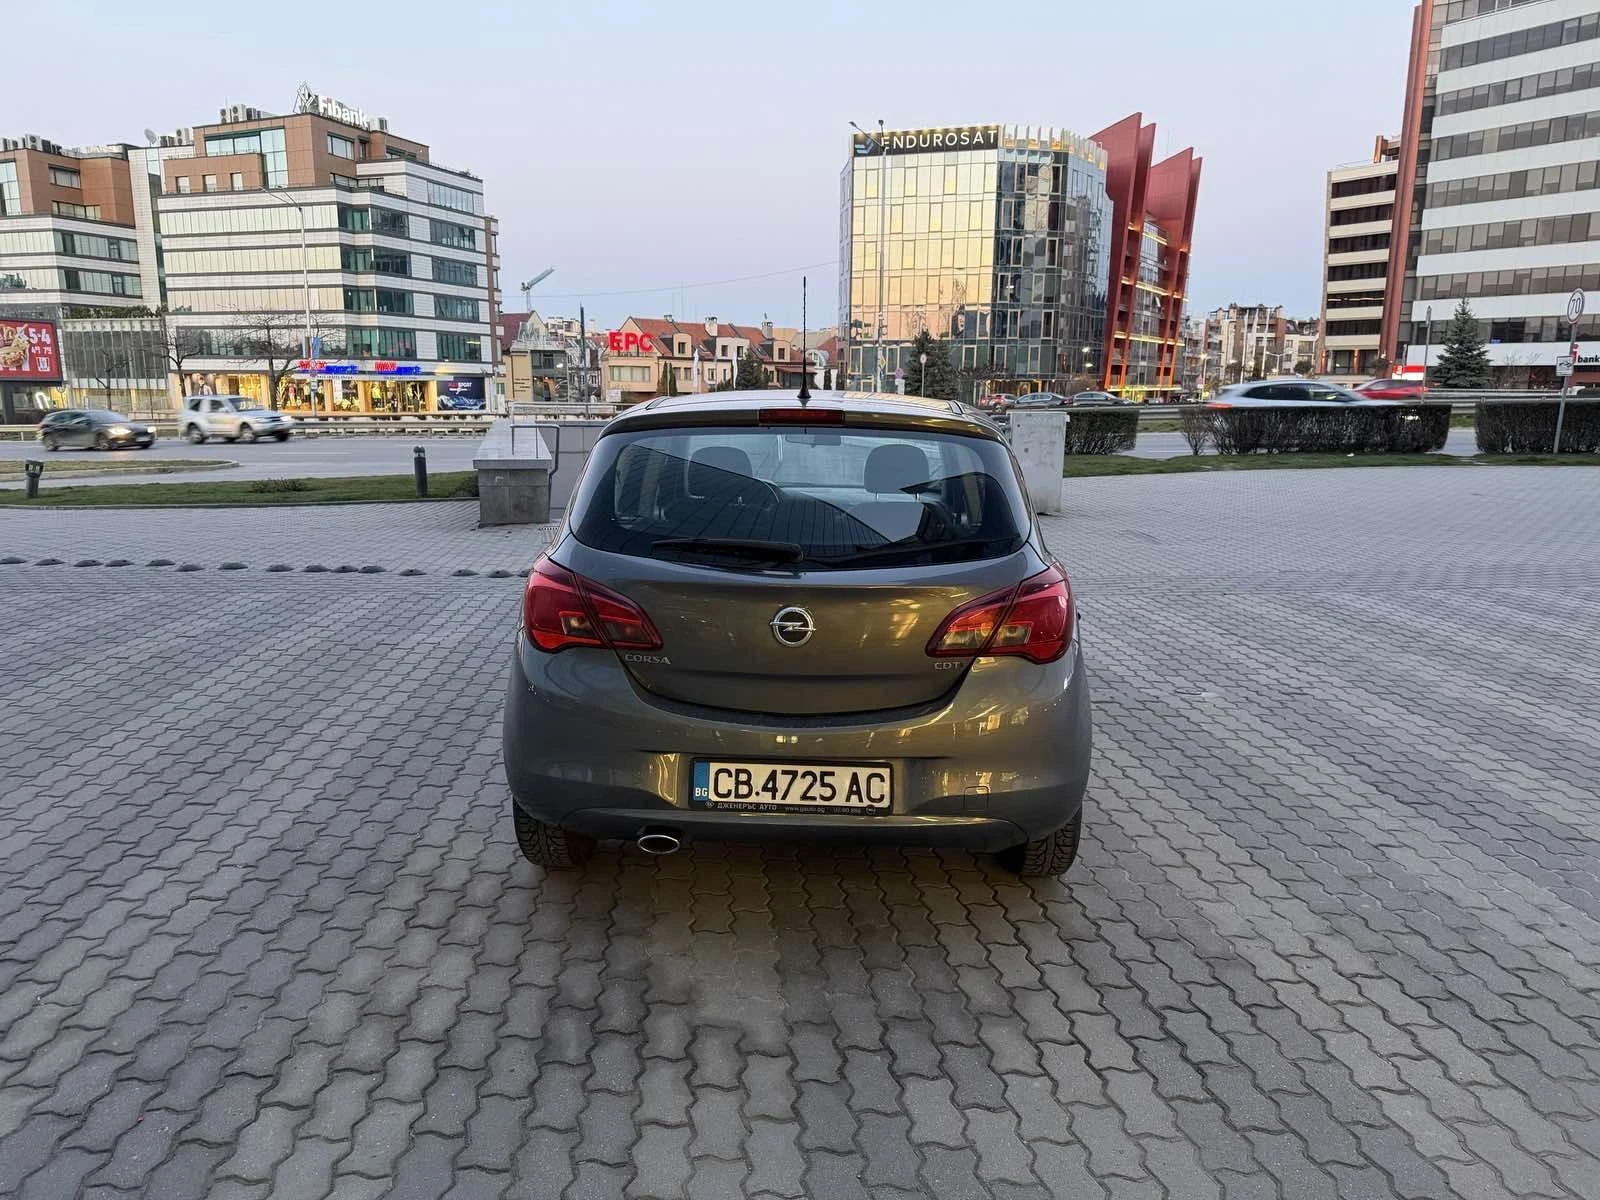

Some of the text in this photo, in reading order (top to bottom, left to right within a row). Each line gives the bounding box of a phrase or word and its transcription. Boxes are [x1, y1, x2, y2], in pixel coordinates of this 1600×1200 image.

[318, 94, 369, 129] Fibank
[881, 130, 997, 150] ENDUROSAT
[1570, 297, 1581, 315] 70
[608, 331, 654, 353] EPC
[624, 653, 672, 665] CORSA
[695, 787, 708, 797] BG
[845, 771, 886, 803] AC
